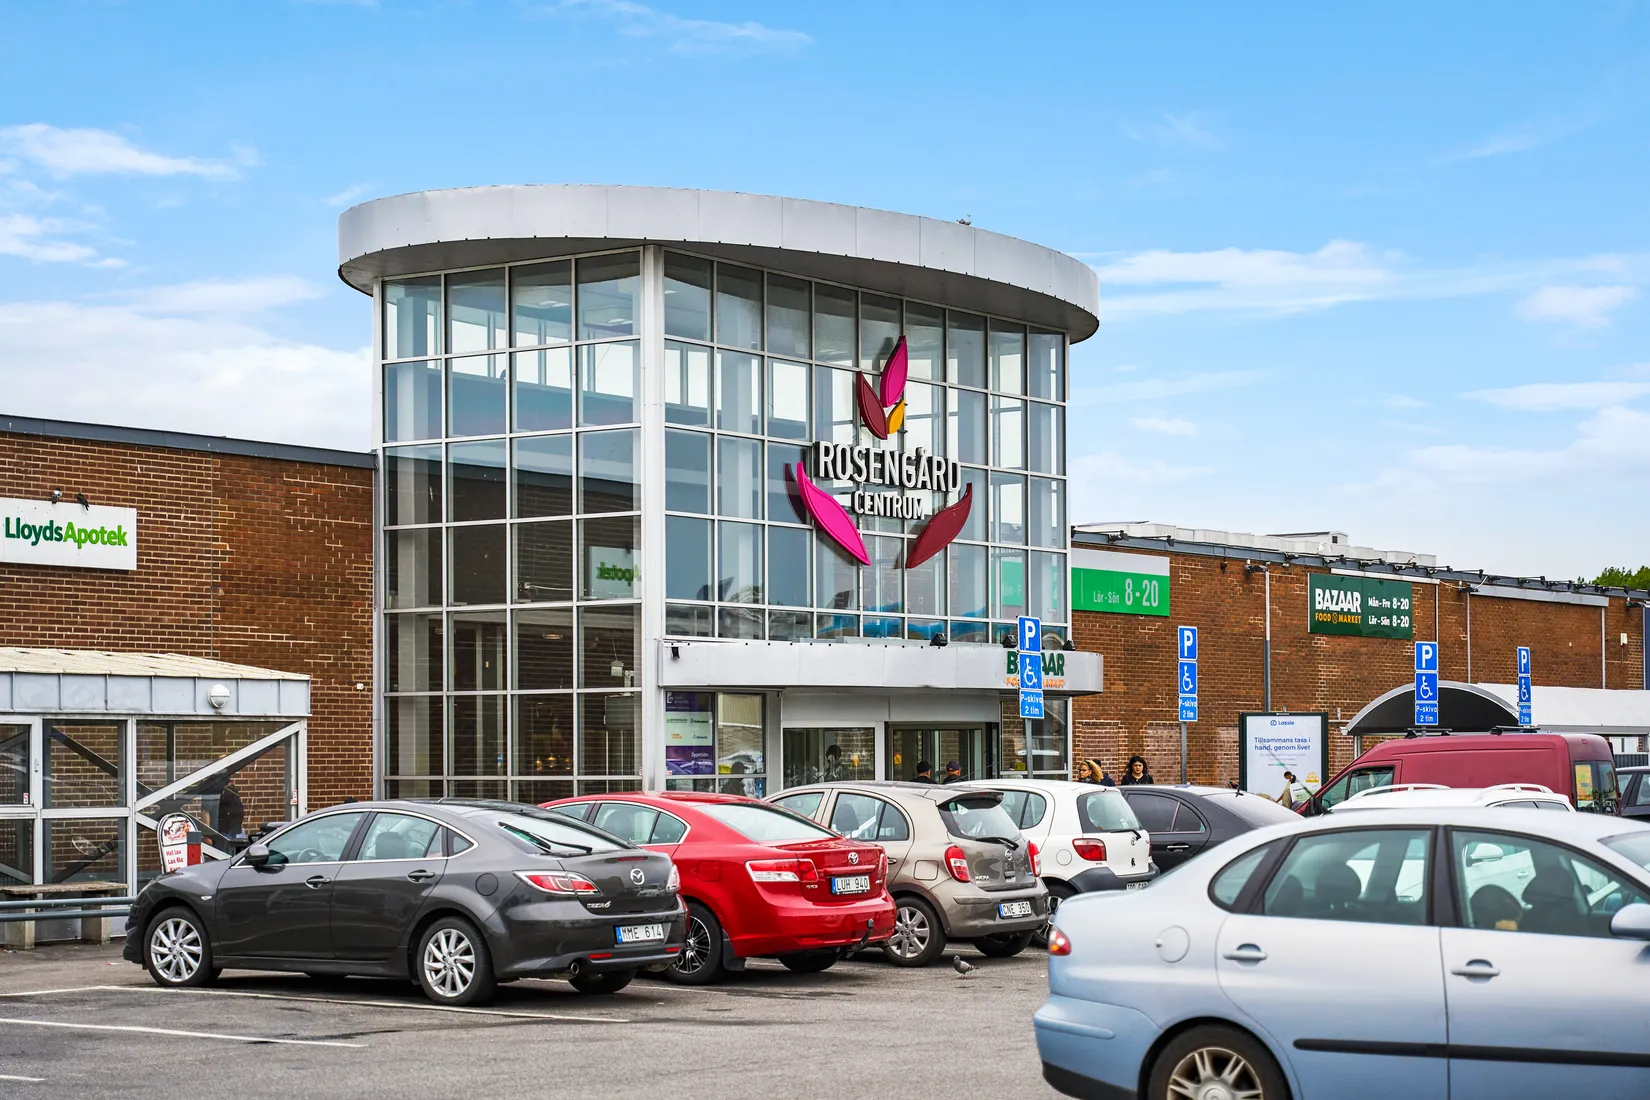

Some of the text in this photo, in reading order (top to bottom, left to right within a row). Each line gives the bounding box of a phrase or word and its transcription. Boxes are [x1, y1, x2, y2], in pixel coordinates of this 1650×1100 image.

[815, 440, 961, 492] ROSENGÅRD
[853, 490, 925, 520] CENTRUM
[5, 516, 128, 549] LloydsApotek
[1315, 588, 1362, 613] BAZAAR
[1392, 597, 1410, 610] 8-20
[1315, 612, 1362, 624] FOOD MARKET
[1392, 615, 1410, 628] 8-20
[1025, 620, 1036, 648] P
[1184, 630, 1194, 656] P
[1422, 645, 1433, 668] P
[1521, 650, 1528, 672] P
[1020, 694, 1043, 704] P-skiva
[1025, 706, 1040, 715] 2 tim
[1183, 710, 1187, 718] 2
[836, 878, 869, 891] LUH 940
[1003, 902, 1030, 915] CNE 350
[622, 925, 661, 939] MME 614
